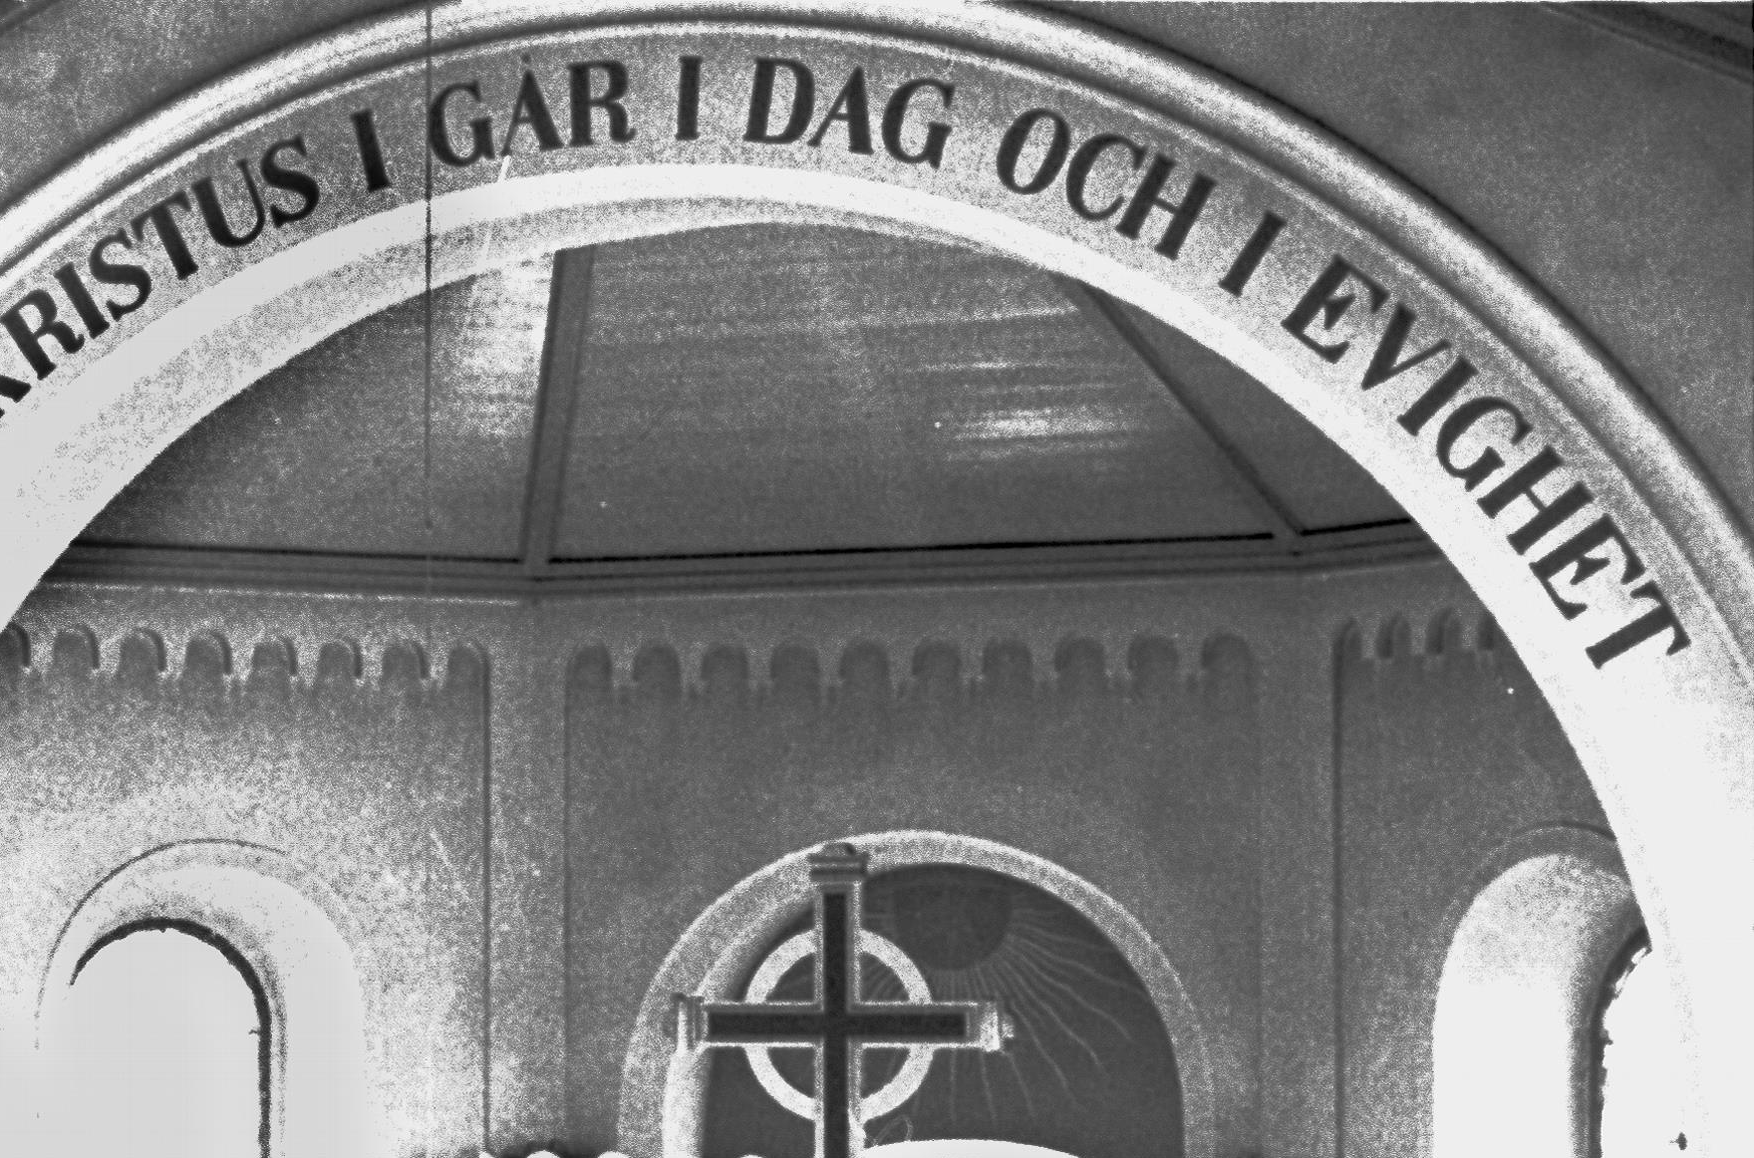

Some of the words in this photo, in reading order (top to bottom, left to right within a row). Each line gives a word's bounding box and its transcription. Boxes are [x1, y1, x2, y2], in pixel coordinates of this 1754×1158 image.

[350, 108, 392, 194] I
[674, 55, 702, 141] I
[744, 56, 955, 170] DAG
[996, 108, 1216, 260] OCH
[1218, 211, 1287, 298] I
[1280, 253, 1692, 670] EVIGHET
